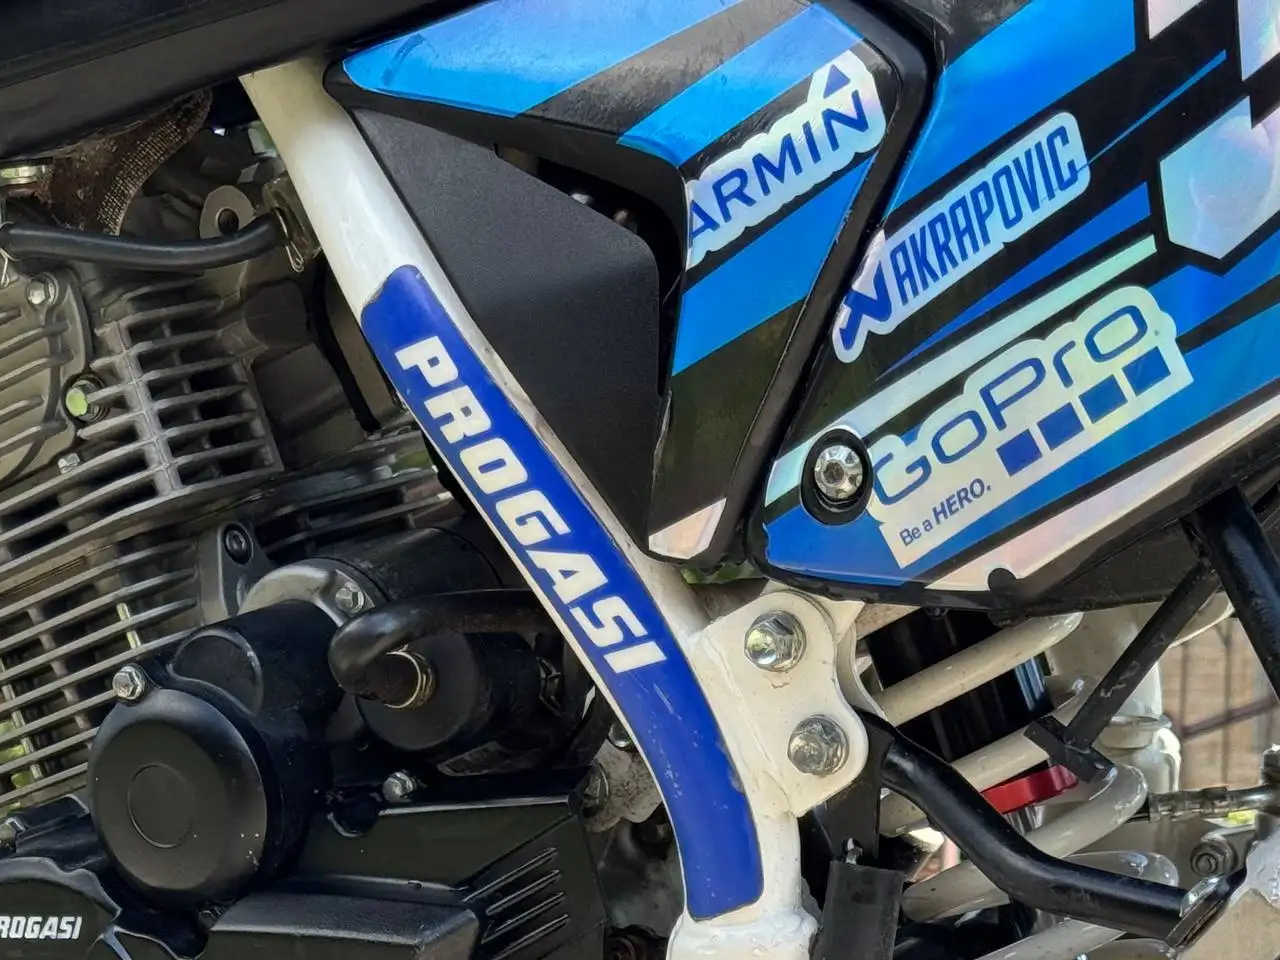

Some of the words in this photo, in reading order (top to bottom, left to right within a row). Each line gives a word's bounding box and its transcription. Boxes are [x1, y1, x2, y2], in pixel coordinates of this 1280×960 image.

[891, 125, 1080, 307] AKRAPOVIC
[872, 304, 1150, 506] GoPro
[395, 336, 667, 674] PROGASI
[900, 528, 922, 547] Be
[923, 519, 933, 532] a
[933, 478, 991, 525] HERO.
